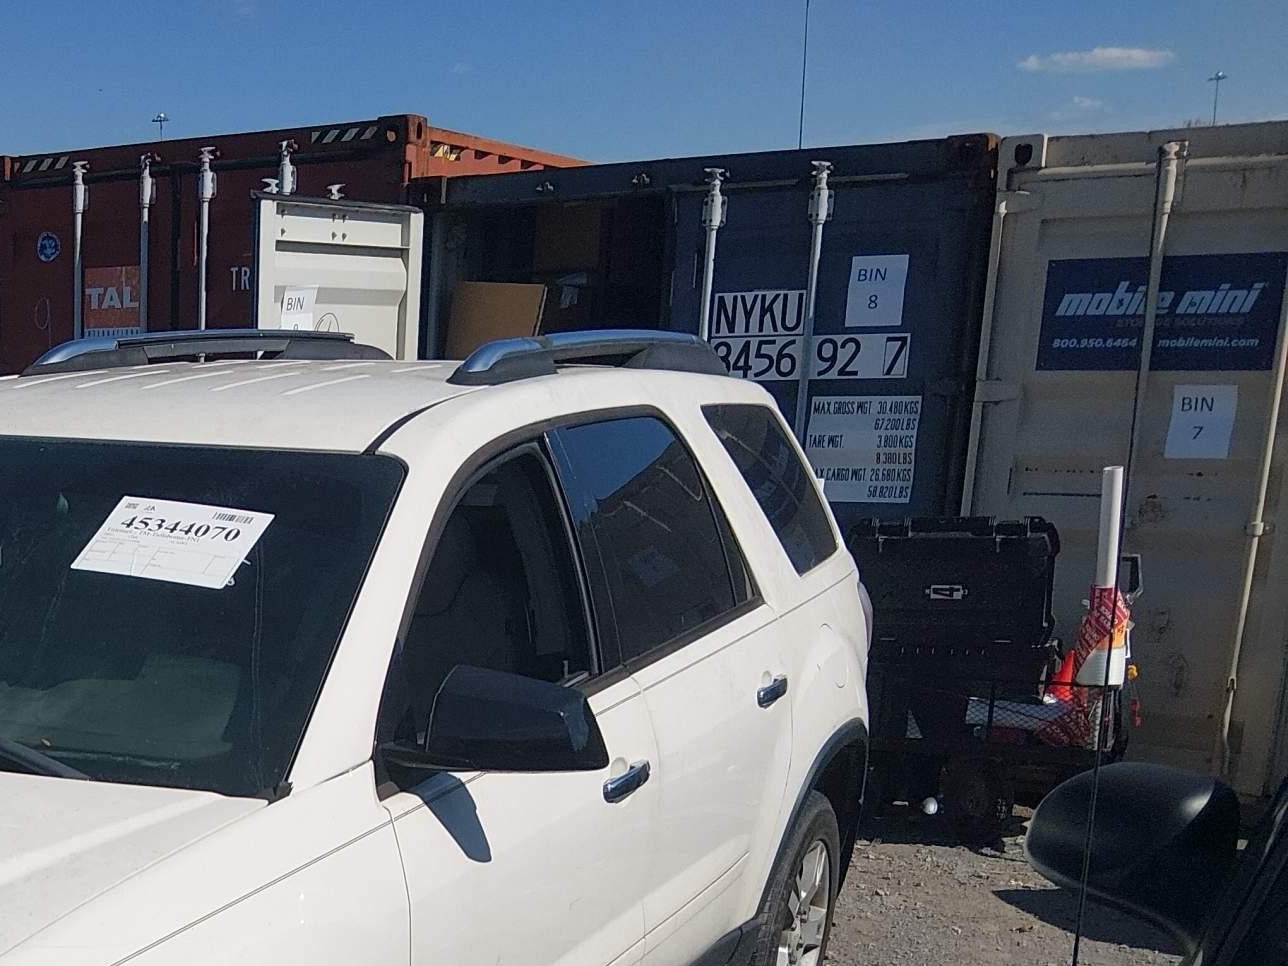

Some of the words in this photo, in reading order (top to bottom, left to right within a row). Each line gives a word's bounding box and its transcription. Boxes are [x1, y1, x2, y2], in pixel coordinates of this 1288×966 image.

[857, 268, 887, 282] BIN
[85, 286, 140, 310] TAL
[287, 297, 305, 311] BIN
[867, 295, 878, 310] 8
[1176, 283, 1264, 314] mini
[715, 293, 804, 334] NYKU
[1158, 336, 1260, 348] mobilemini.com
[817, 338, 861, 377] 92
[883, 336, 908, 376] 7
[833, 401, 856, 414] GROSS
[1181, 397, 1214, 412] BIN
[1192, 426, 1203, 440] 7
[809, 434, 827, 448] TARE
[121, 515, 241, 542] 45344070
